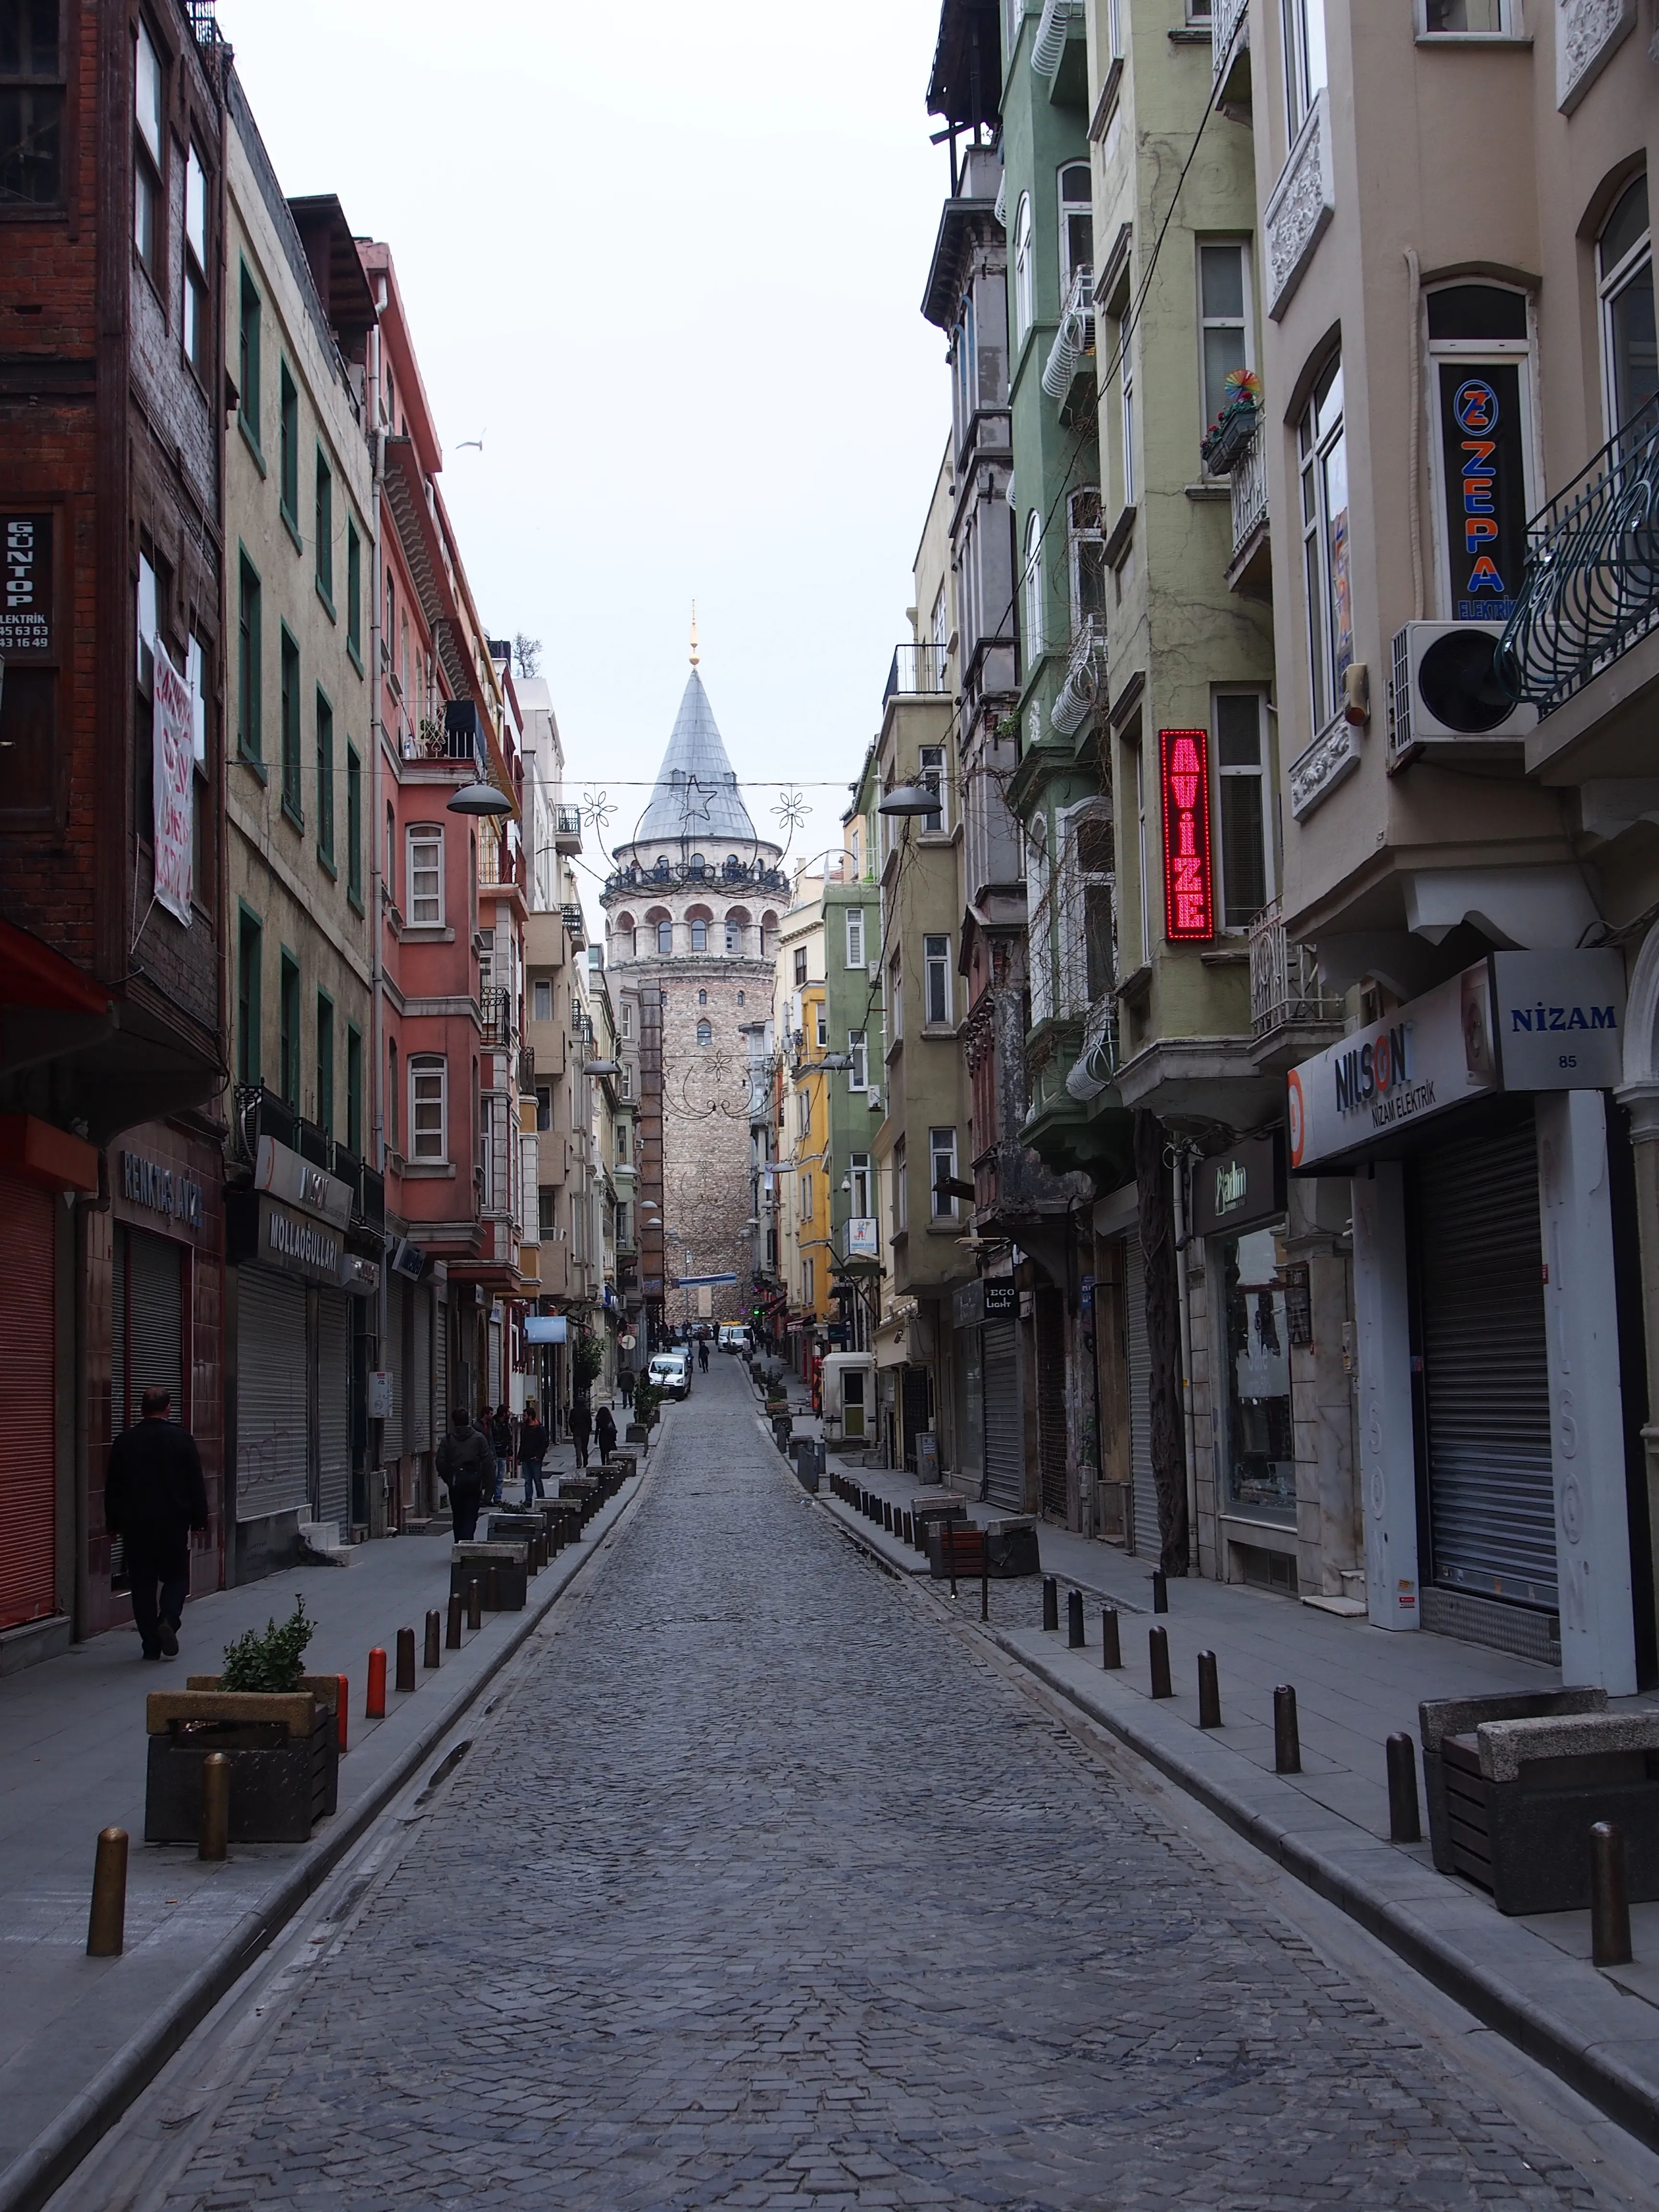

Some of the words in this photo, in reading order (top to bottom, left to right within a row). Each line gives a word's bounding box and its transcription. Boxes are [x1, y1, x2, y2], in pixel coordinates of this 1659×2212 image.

[1461, 441, 1505, 592] ZEPA
[6, 521, 34, 607] GÜNTOP
[0, 613, 46, 624] LEKTRİK
[15, 626, 30, 636] 63
[33, 626, 48, 636] 63
[17, 638, 30, 647] 16
[32, 638, 48, 647] 49
[1171, 738, 1205, 928] AVİZE
[1511, 1001, 1618, 1032] NİZAM
[1335, 1023, 1407, 1112] NILSON
[1559, 1056, 1577, 1068] 85
[1371, 1099, 1395, 1129] NİZAM
[1397, 1079, 1436, 1118] ELEKTRİK
[270, 1212, 337, 1272] MOLLAOĞULLARI
